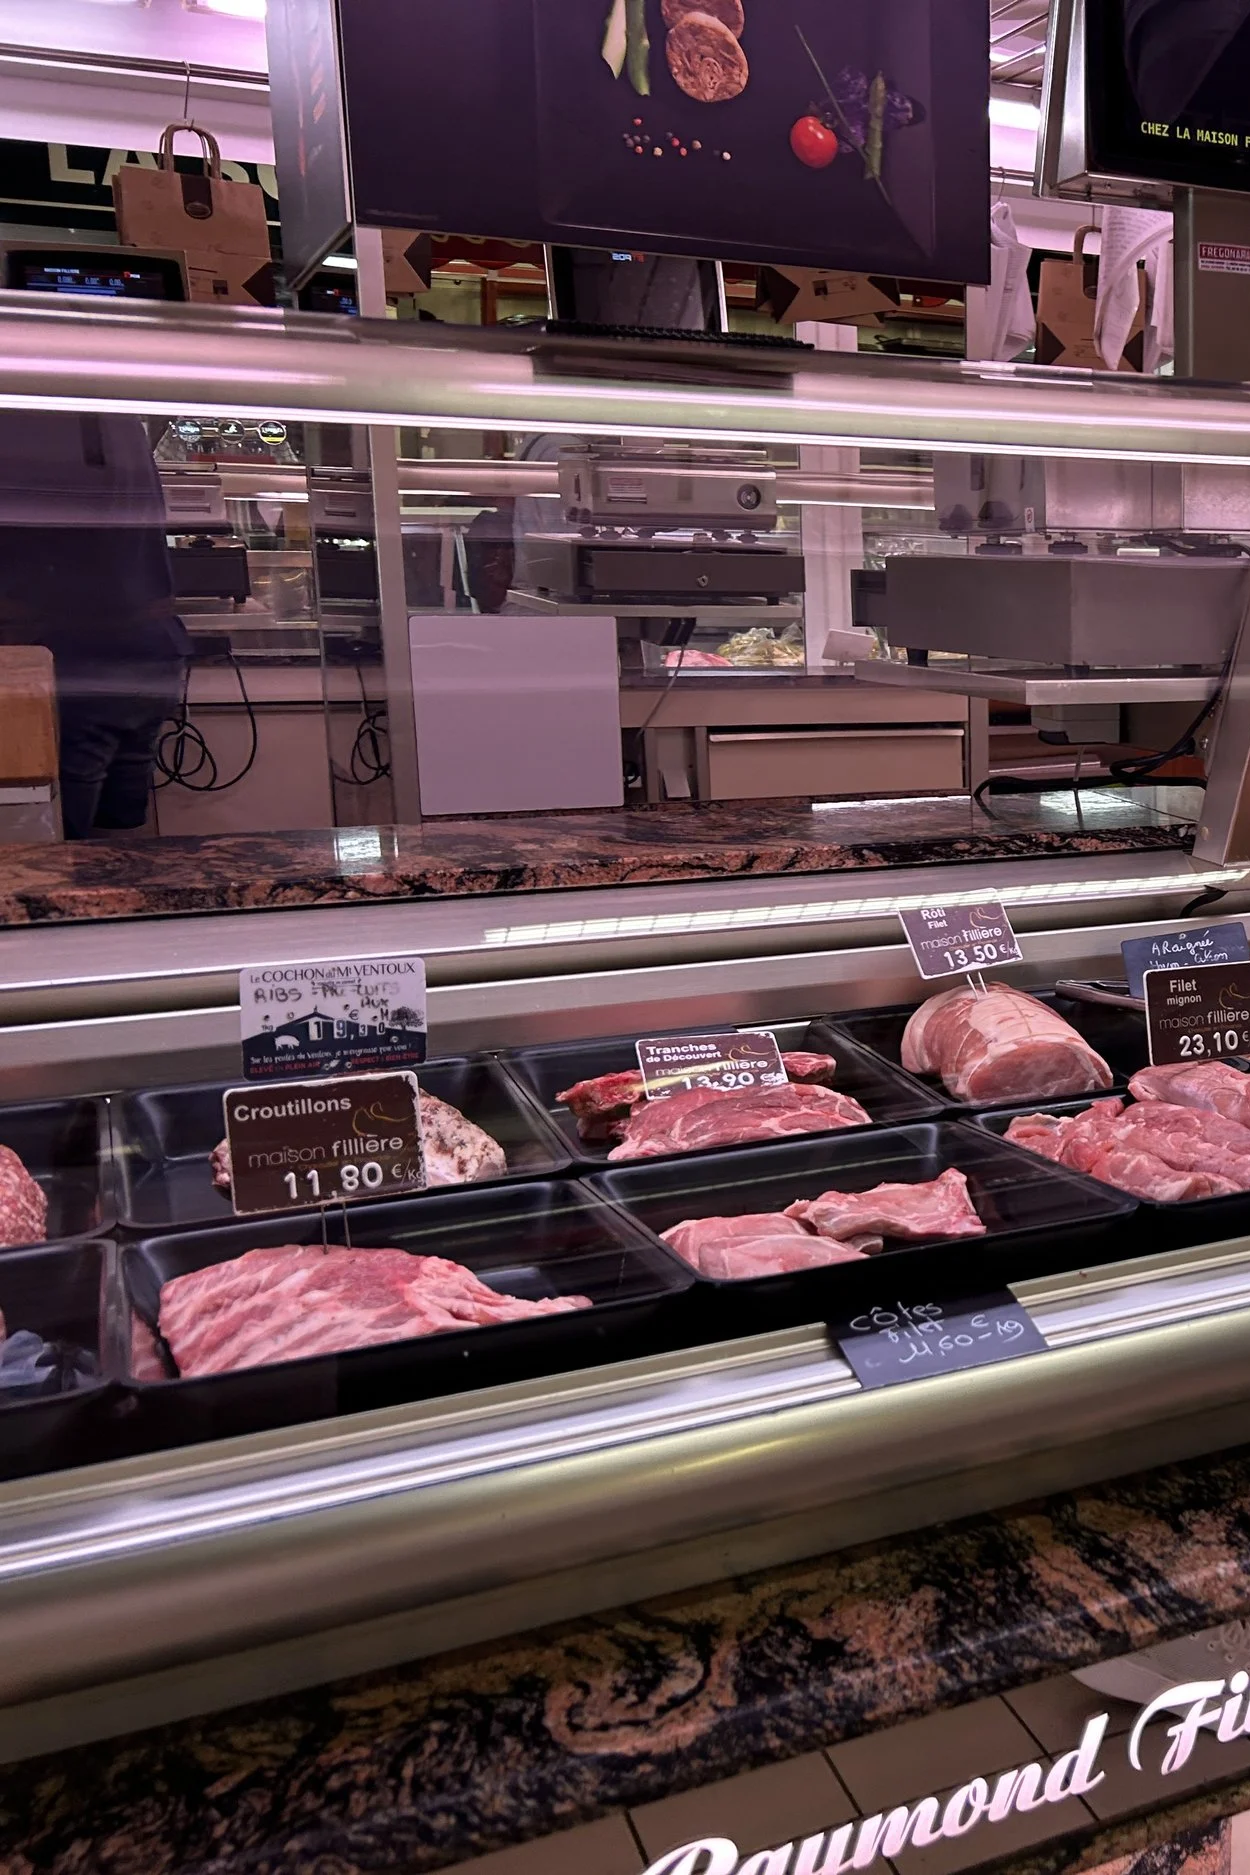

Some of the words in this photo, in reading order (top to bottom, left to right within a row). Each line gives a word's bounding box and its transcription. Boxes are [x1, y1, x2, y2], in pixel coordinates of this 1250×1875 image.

[1141, 121, 1170, 137] CHEZ
[1176, 126, 1191, 140] LA
[1197, 129, 1239, 146] MAISON
[920, 907, 946, 920] Rôti
[927, 919, 948, 930] Filet
[921, 935, 963, 951] maison
[262, 967, 325, 984] COCHON
[353, 962, 416, 977] VENTOUX
[1169, 979, 1198, 993] Filet
[1166, 994, 1202, 1007] mignon
[1159, 1014, 1205, 1030] maison
[645, 1042, 717, 1056] Tranches
[1179, 1029, 1239, 1057] 23,10
[664, 1050, 722, 1063] Découvert
[234, 1096, 352, 1122] Croutillons
[248, 1145, 326, 1168] maison
[284, 1161, 384, 1200] 11,80
